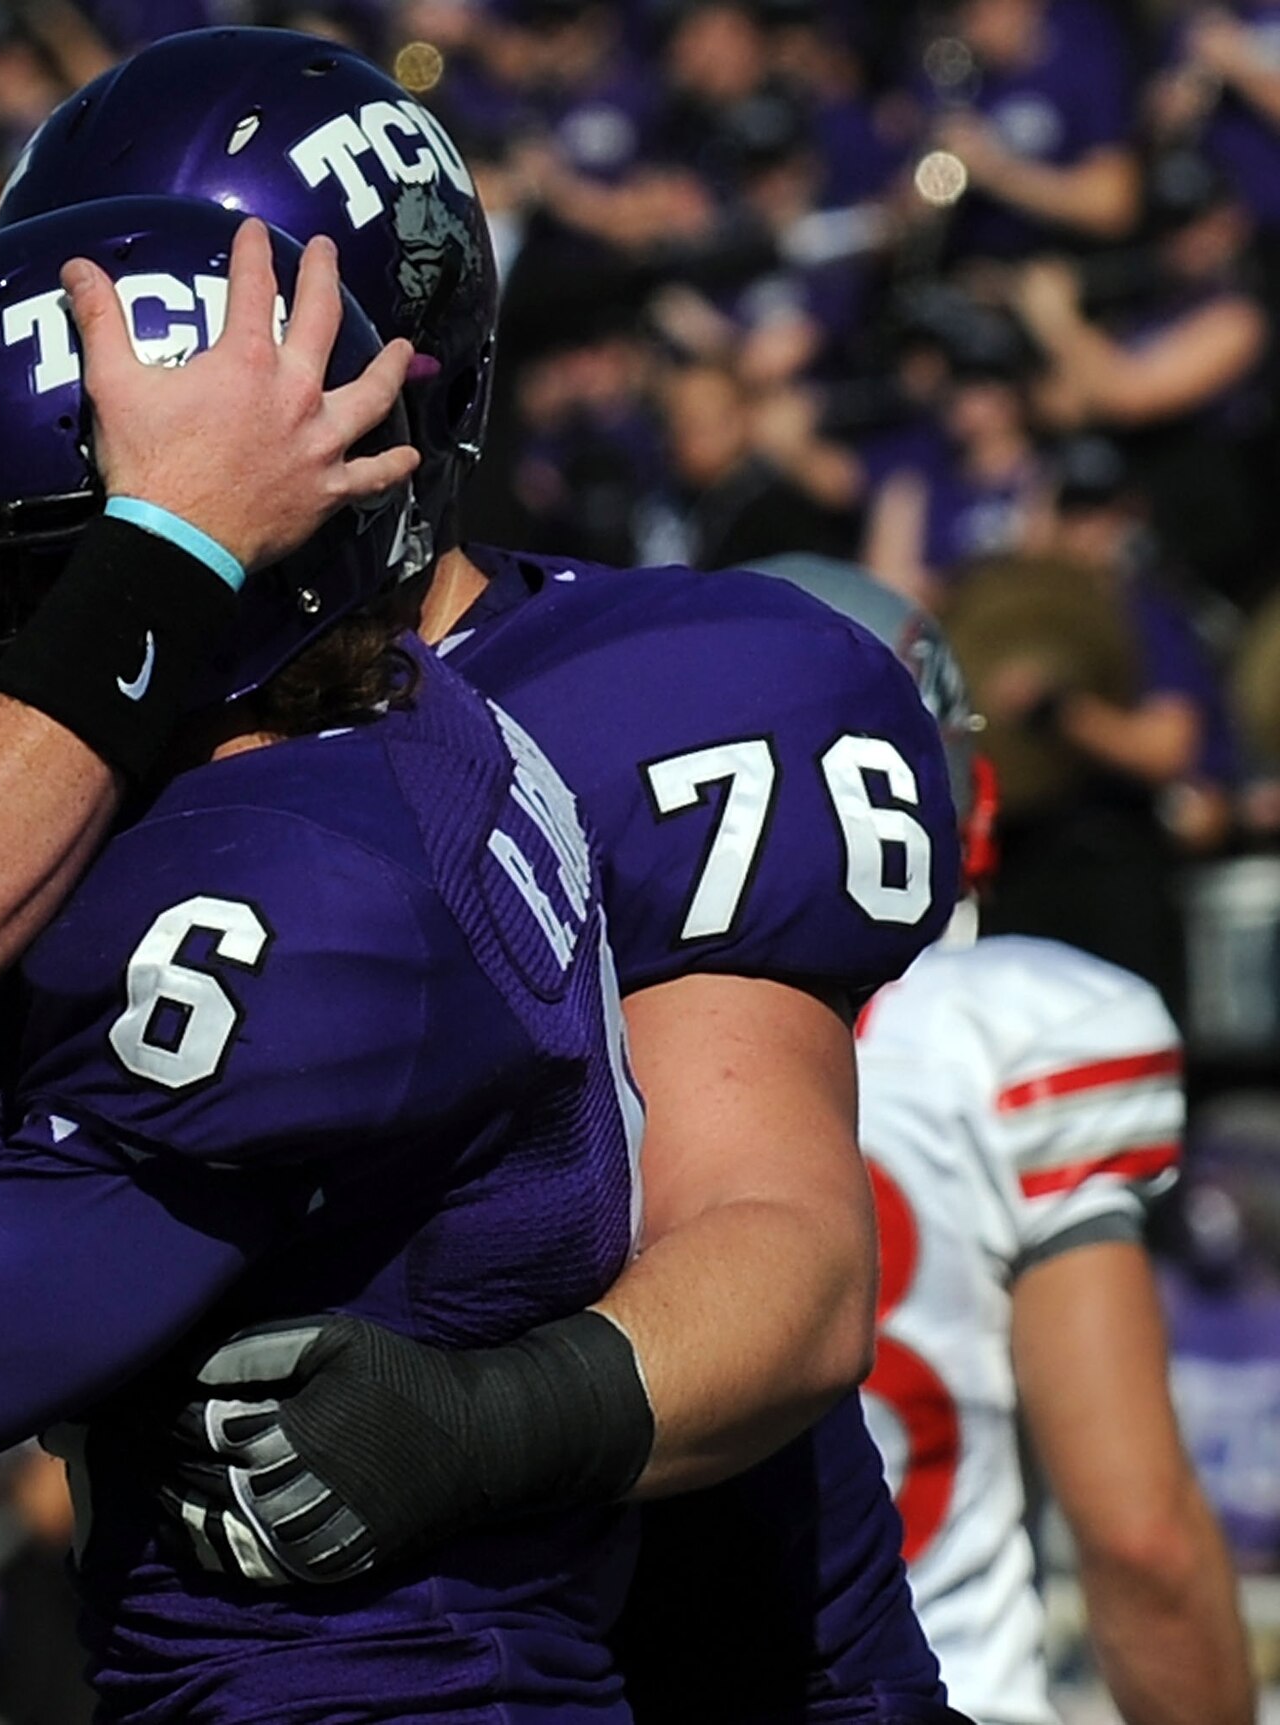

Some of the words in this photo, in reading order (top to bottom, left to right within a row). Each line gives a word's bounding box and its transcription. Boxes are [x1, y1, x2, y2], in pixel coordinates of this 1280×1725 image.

[289, 100, 475, 229] TCU
[646, 734, 932, 940] 76
[108, 895, 268, 1089] 6
